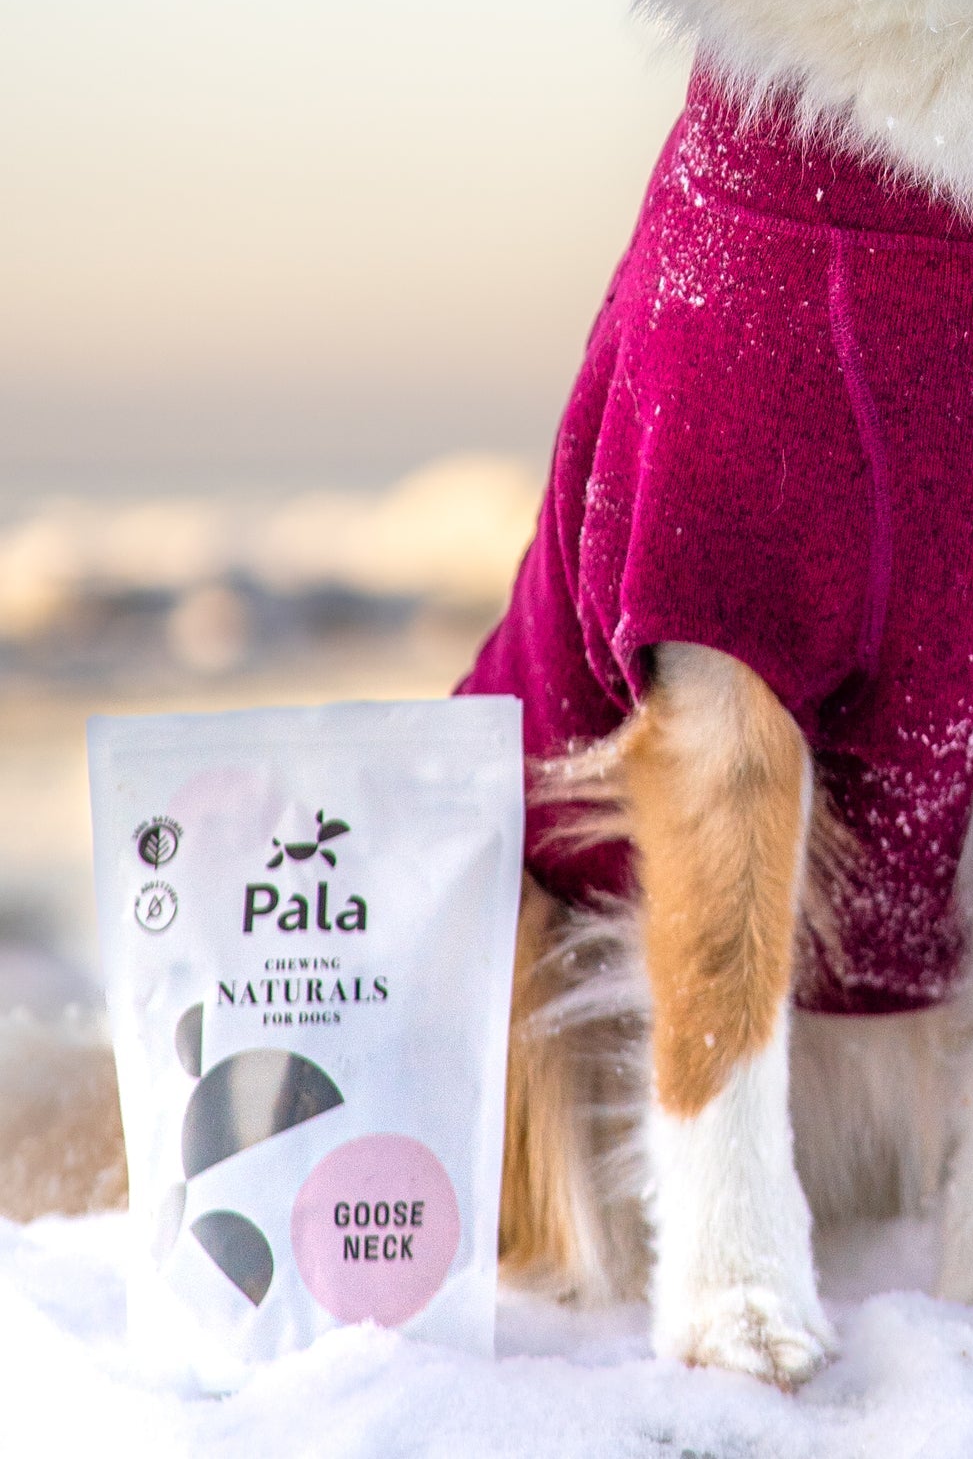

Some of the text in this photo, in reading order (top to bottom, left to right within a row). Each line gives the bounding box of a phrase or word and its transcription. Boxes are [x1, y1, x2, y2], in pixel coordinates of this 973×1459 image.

[243, 881, 367, 932] Pala
[265, 956, 341, 971] CHEWING
[217, 976, 389, 1005] NATURALS
[263, 1011, 341, 1025] FOR DOGS
[334, 1200, 424, 1228] GOOSE
[343, 1234, 413, 1260] NECK
